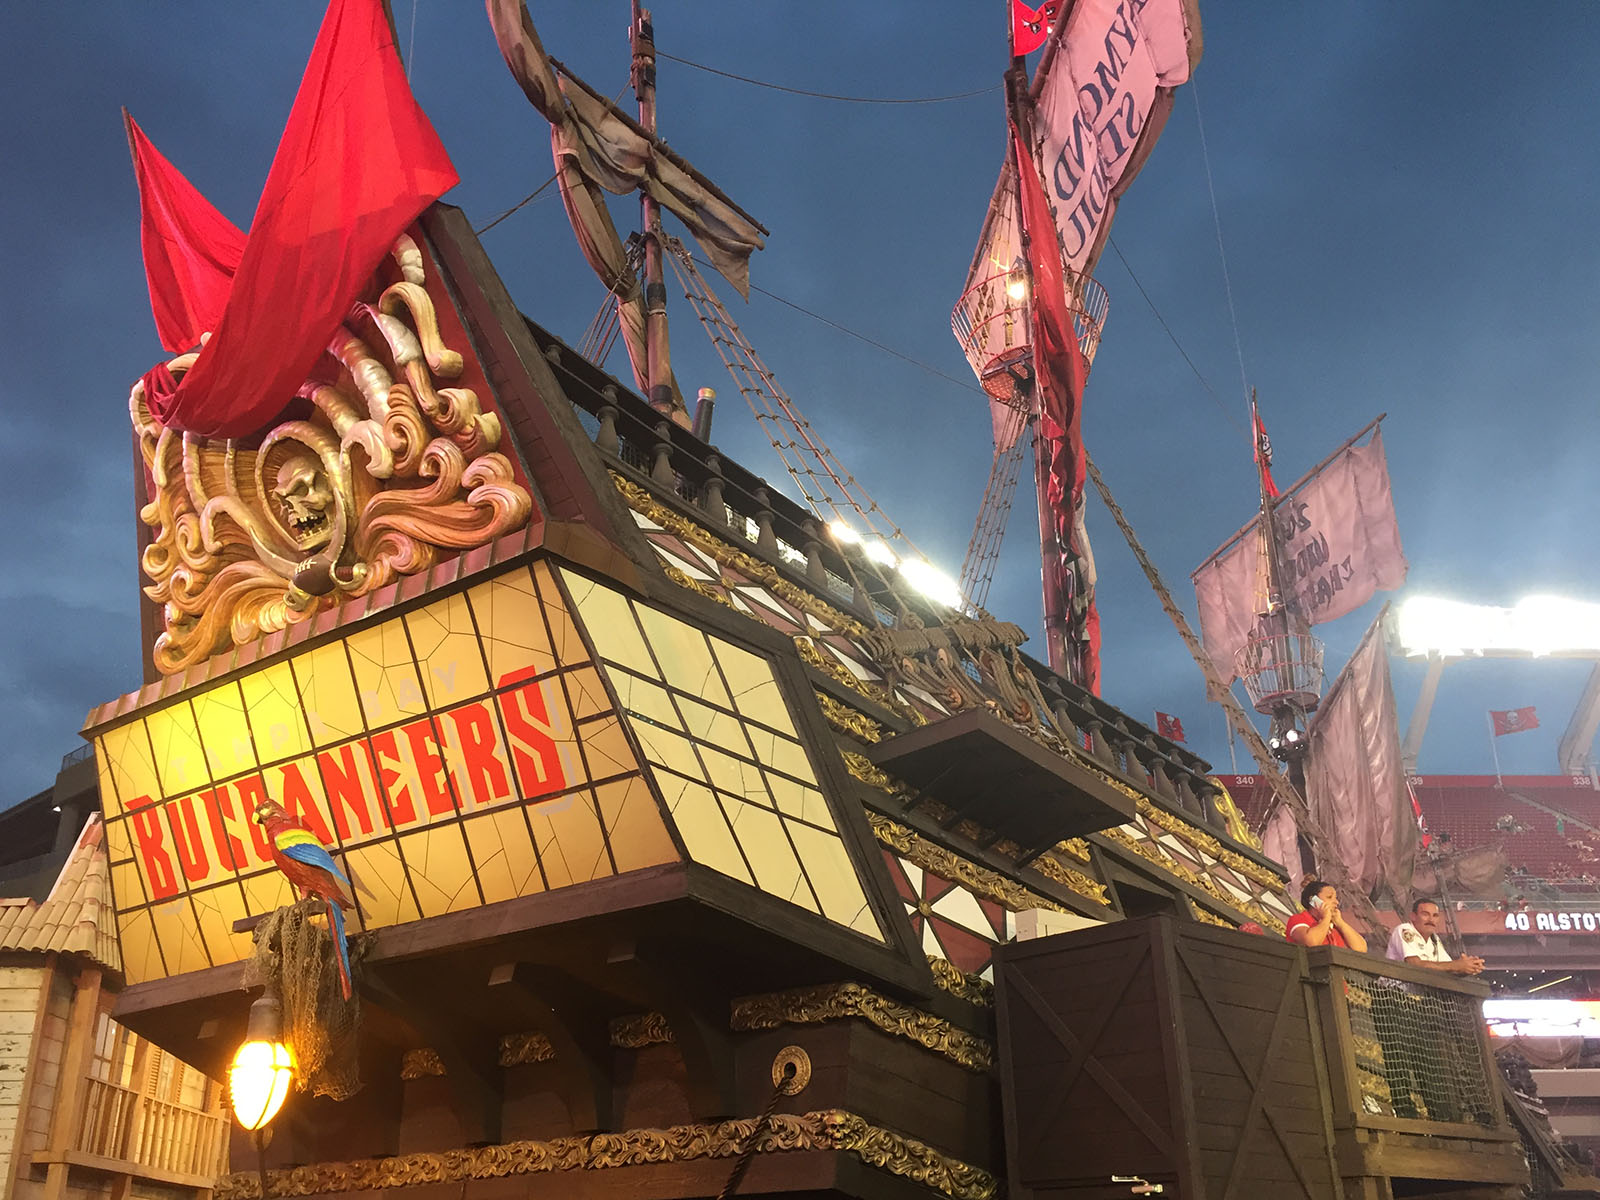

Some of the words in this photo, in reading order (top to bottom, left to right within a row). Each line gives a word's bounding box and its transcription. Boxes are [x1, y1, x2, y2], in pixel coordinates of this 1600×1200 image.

[364, 661, 459, 722] BAY
[124, 664, 567, 901] BUCCANEERS
[1235, 776, 1255, 785] 340
[1573, 776, 1591, 786] 338
[1505, 912, 1531, 931] 40
